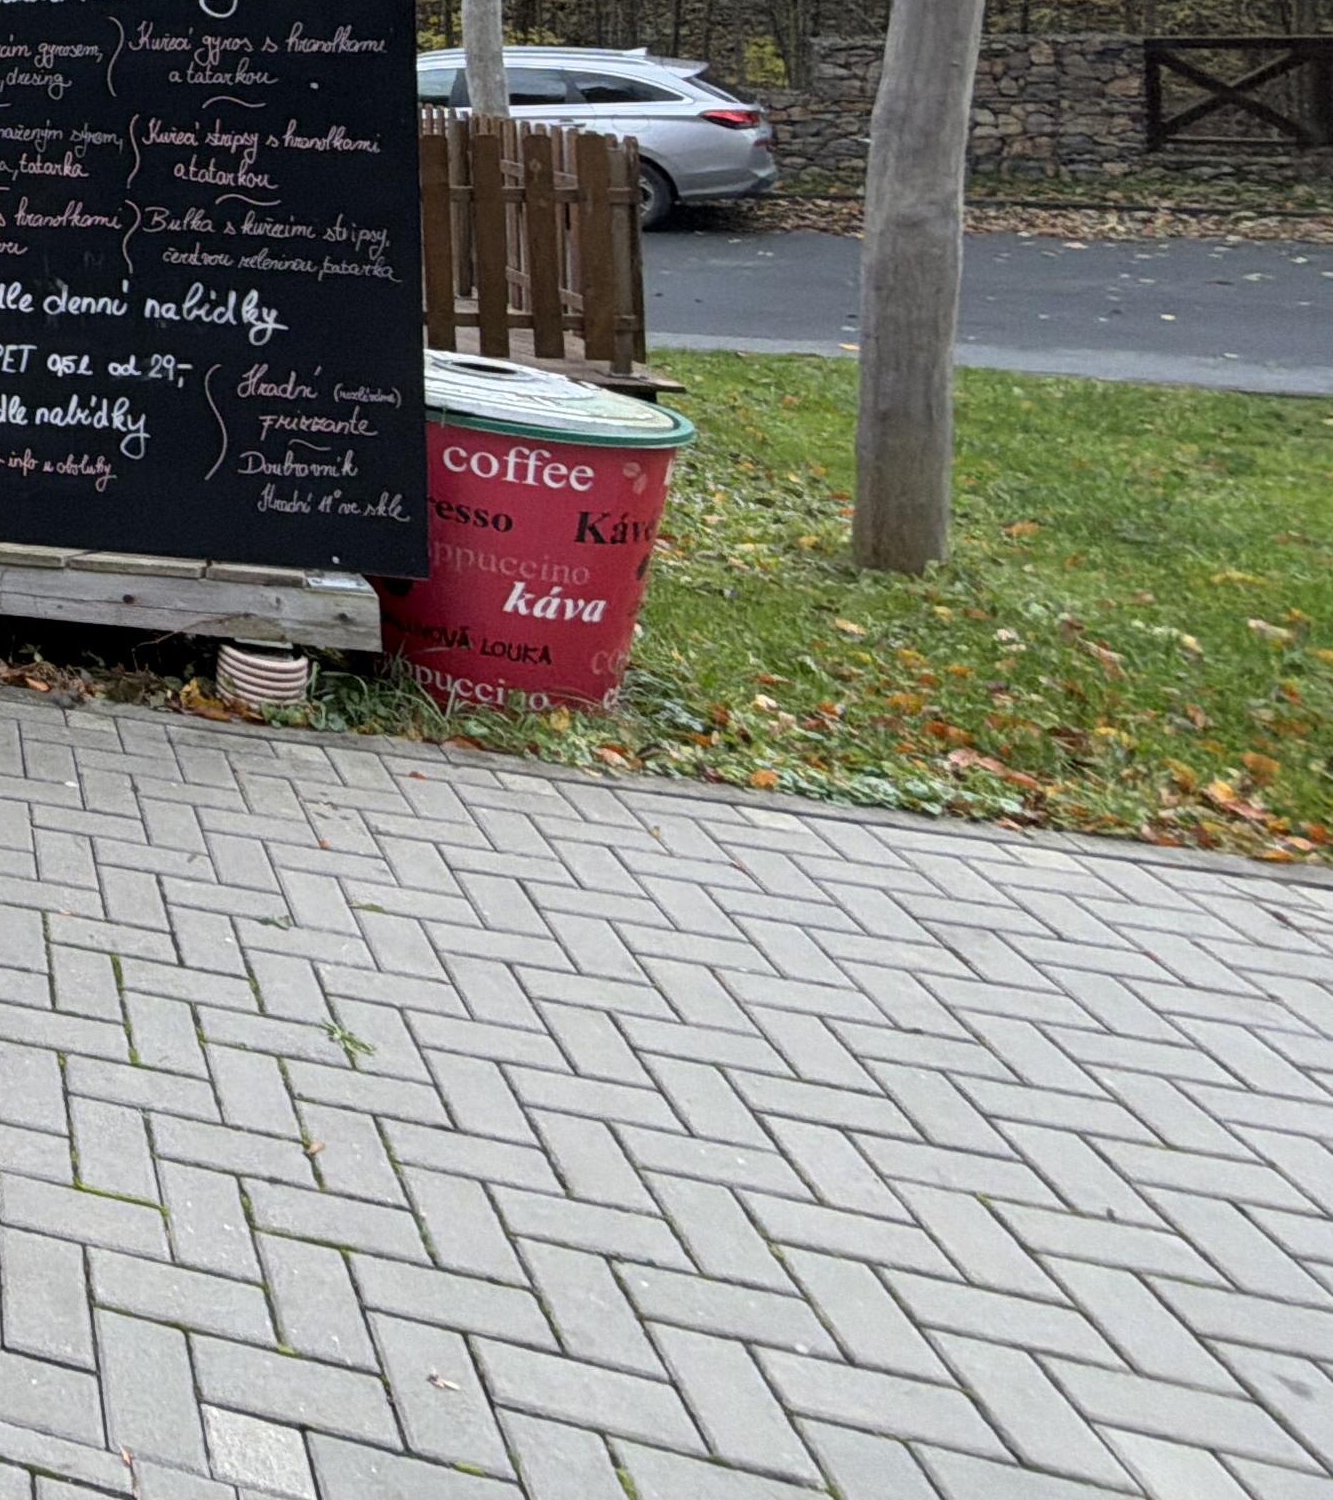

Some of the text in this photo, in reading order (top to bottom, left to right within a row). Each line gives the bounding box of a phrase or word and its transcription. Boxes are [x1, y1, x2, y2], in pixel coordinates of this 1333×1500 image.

[128, 20, 194, 51] Kuřecí
[194, 35, 253, 67] gyros
[261, 36, 279, 53] s
[169, 57, 279, 85] a tatarkou
[141, 117, 200, 145] Kuřecí
[265, 131, 280, 146] s
[283, 119, 381, 154] hranolkami
[173, 154, 279, 190] a tatarkou
[14, 196, 123, 230] hranolkami
[142, 206, 216, 233] Bulka
[223, 220, 237, 236] s
[42, 278, 130, 316] denní
[143, 281, 289, 346] nabídky
[107, 354, 142, 376] od
[236, 363, 322, 399] Hradní
[35, 393, 152, 460] nabídky
[443, 446, 596, 491] coffee
[363, 491, 411, 522] skle
[431, 497, 514, 533] esso
[430, 541, 591, 586] ppuccino
[503, 581, 607, 623] káva
[480, 637, 552, 666] LOUKA
